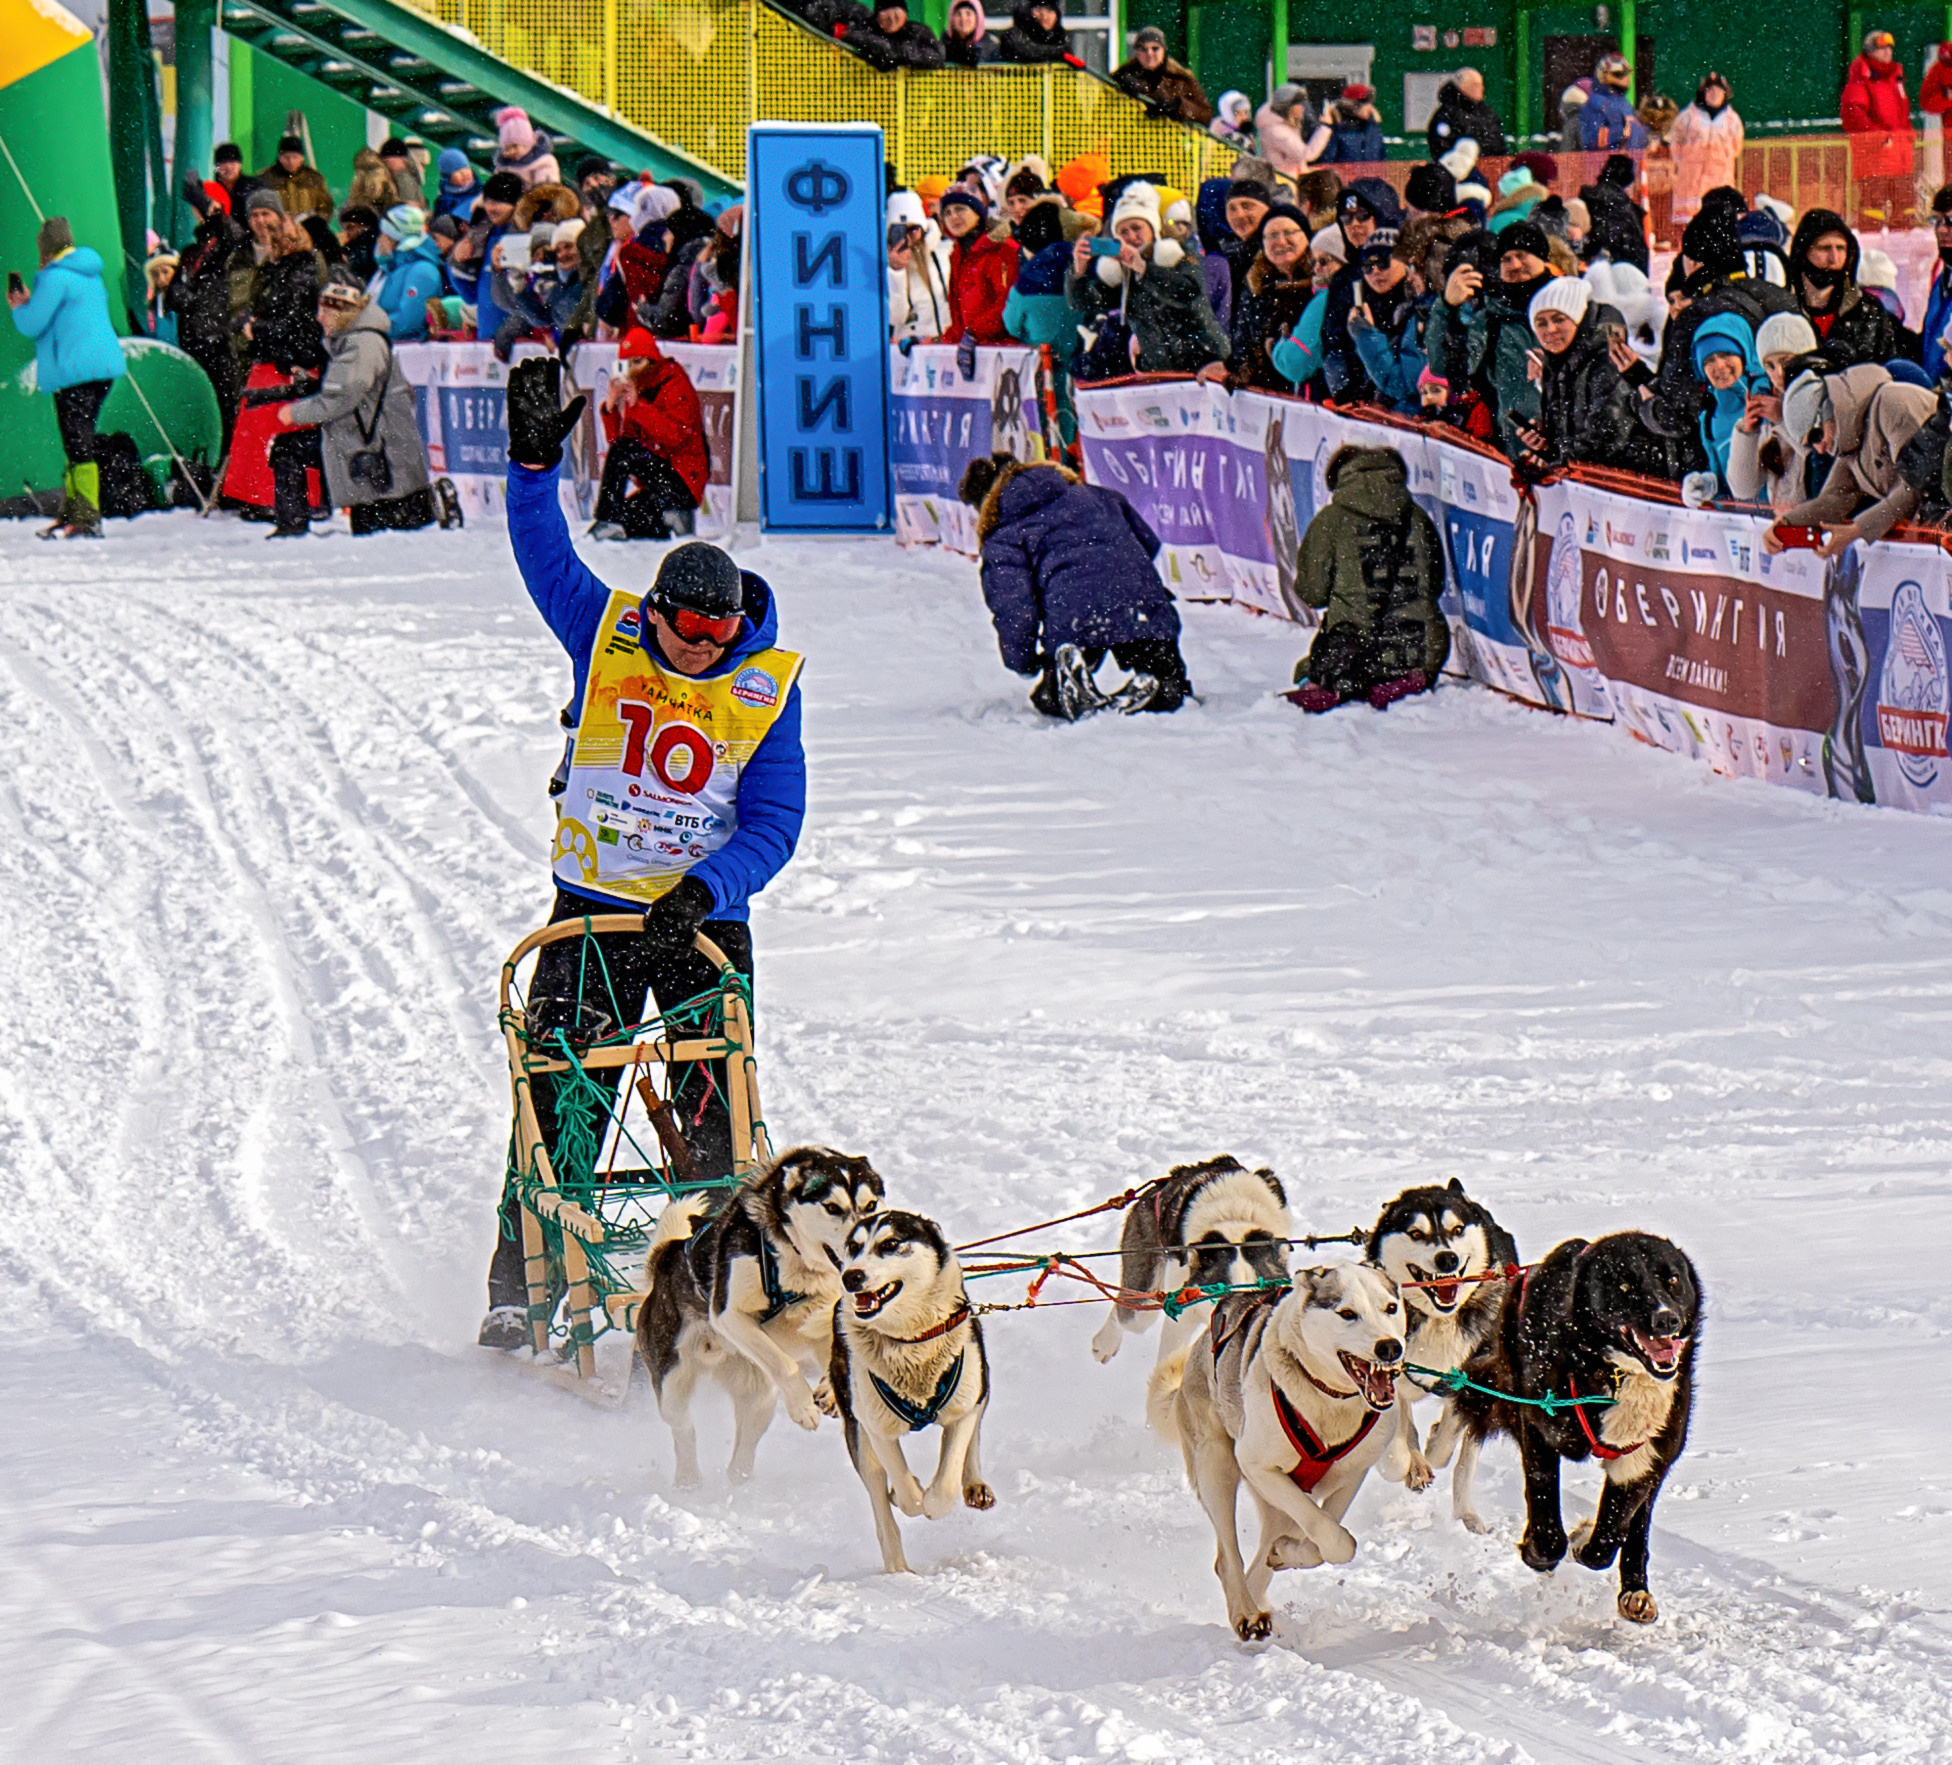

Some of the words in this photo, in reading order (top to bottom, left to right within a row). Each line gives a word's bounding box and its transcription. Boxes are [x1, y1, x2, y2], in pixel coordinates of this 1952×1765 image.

[785, 160, 863, 502] ФИНИШ
[619, 700, 715, 796] 10
[674, 814, 700, 828] ВТБ
